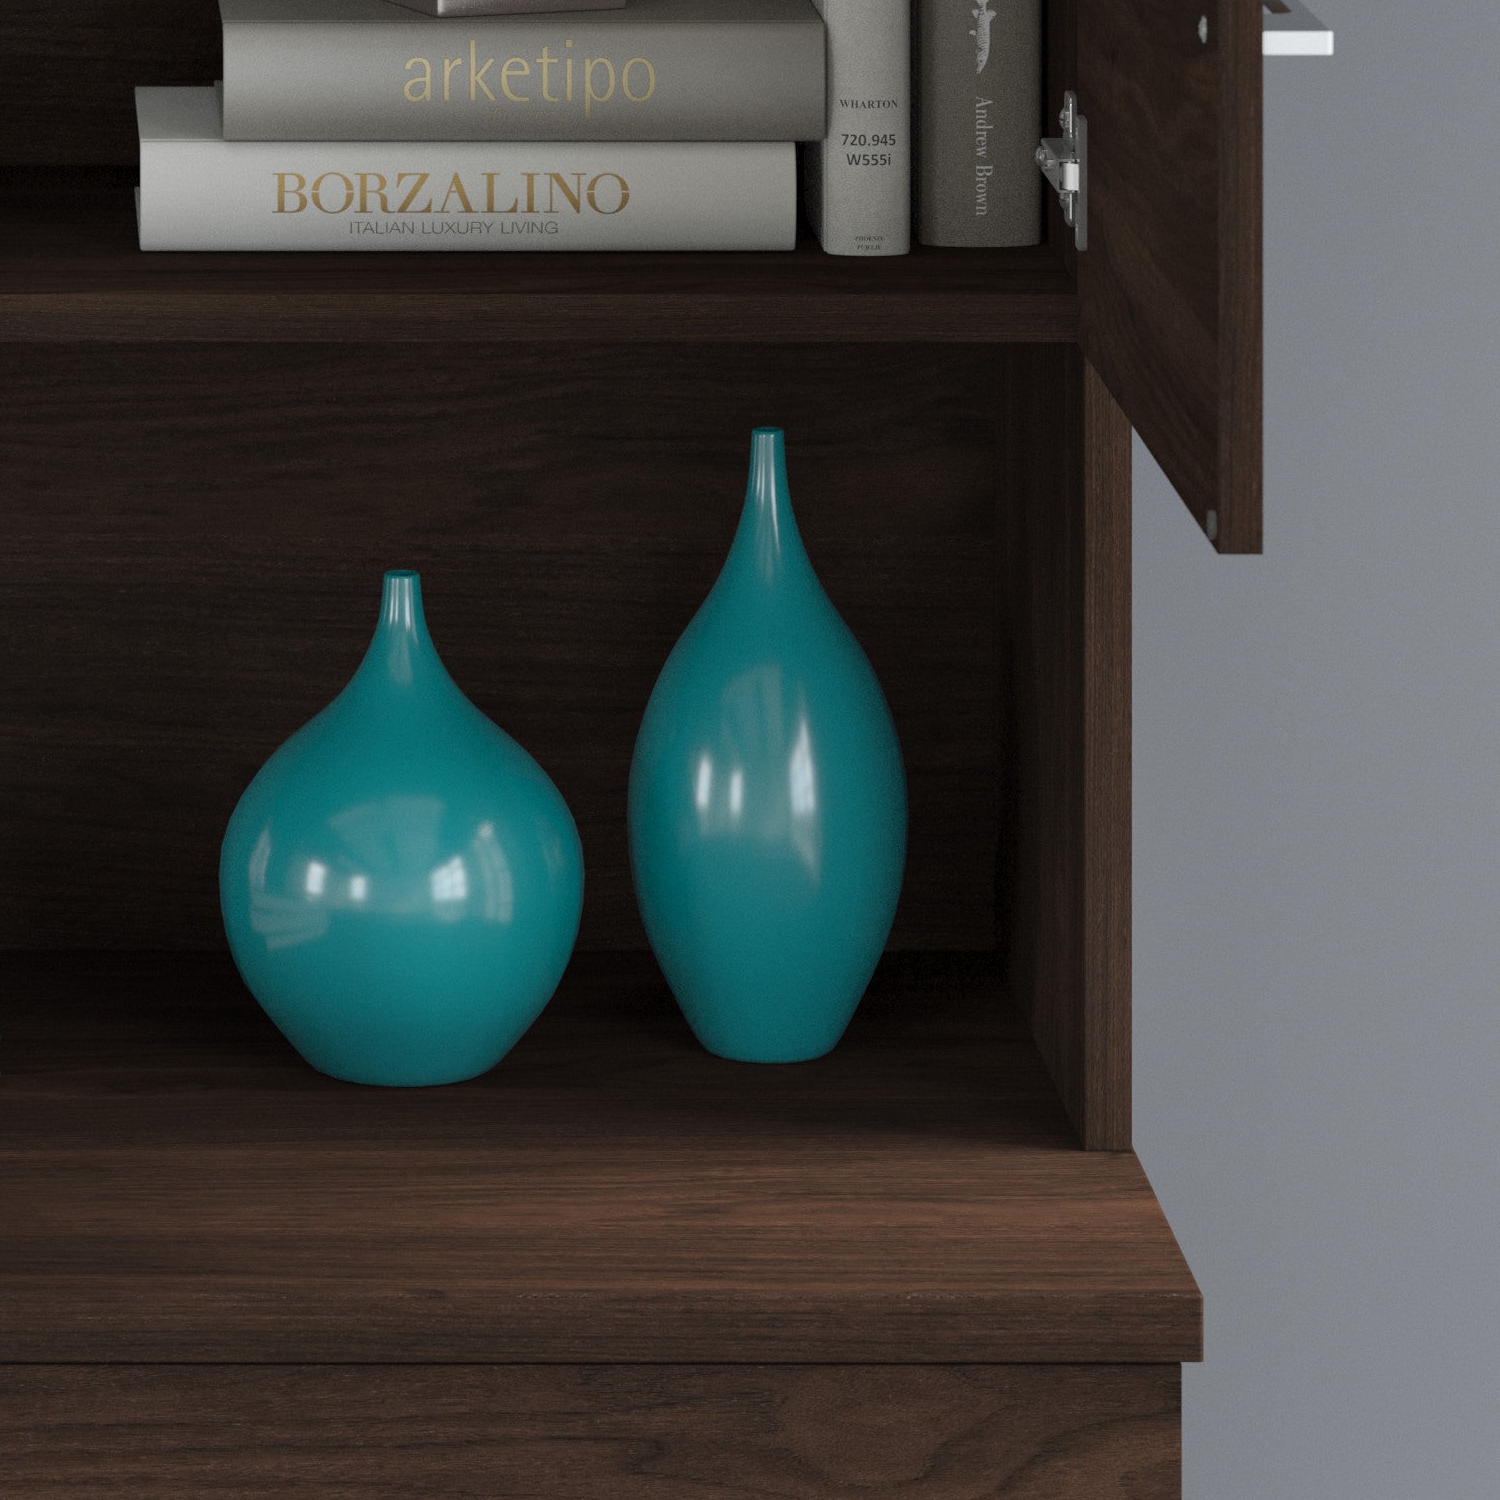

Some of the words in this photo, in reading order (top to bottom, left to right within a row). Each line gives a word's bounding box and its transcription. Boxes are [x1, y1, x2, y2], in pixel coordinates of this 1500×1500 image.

[403, 40, 656, 118] arketipo
[840, 100, 898, 109] WHARTON
[841, 134, 896, 146] 720.945
[975, 97, 994, 159] Andrew
[846, 153, 891, 166] W555i
[271, 172, 630, 214] BORZALINO
[975, 165, 994, 216] Brown
[349, 221, 416, 235] ITALIAN
[421, 221, 494, 235] LUXURY
[500, 221, 559, 235] LIVING
